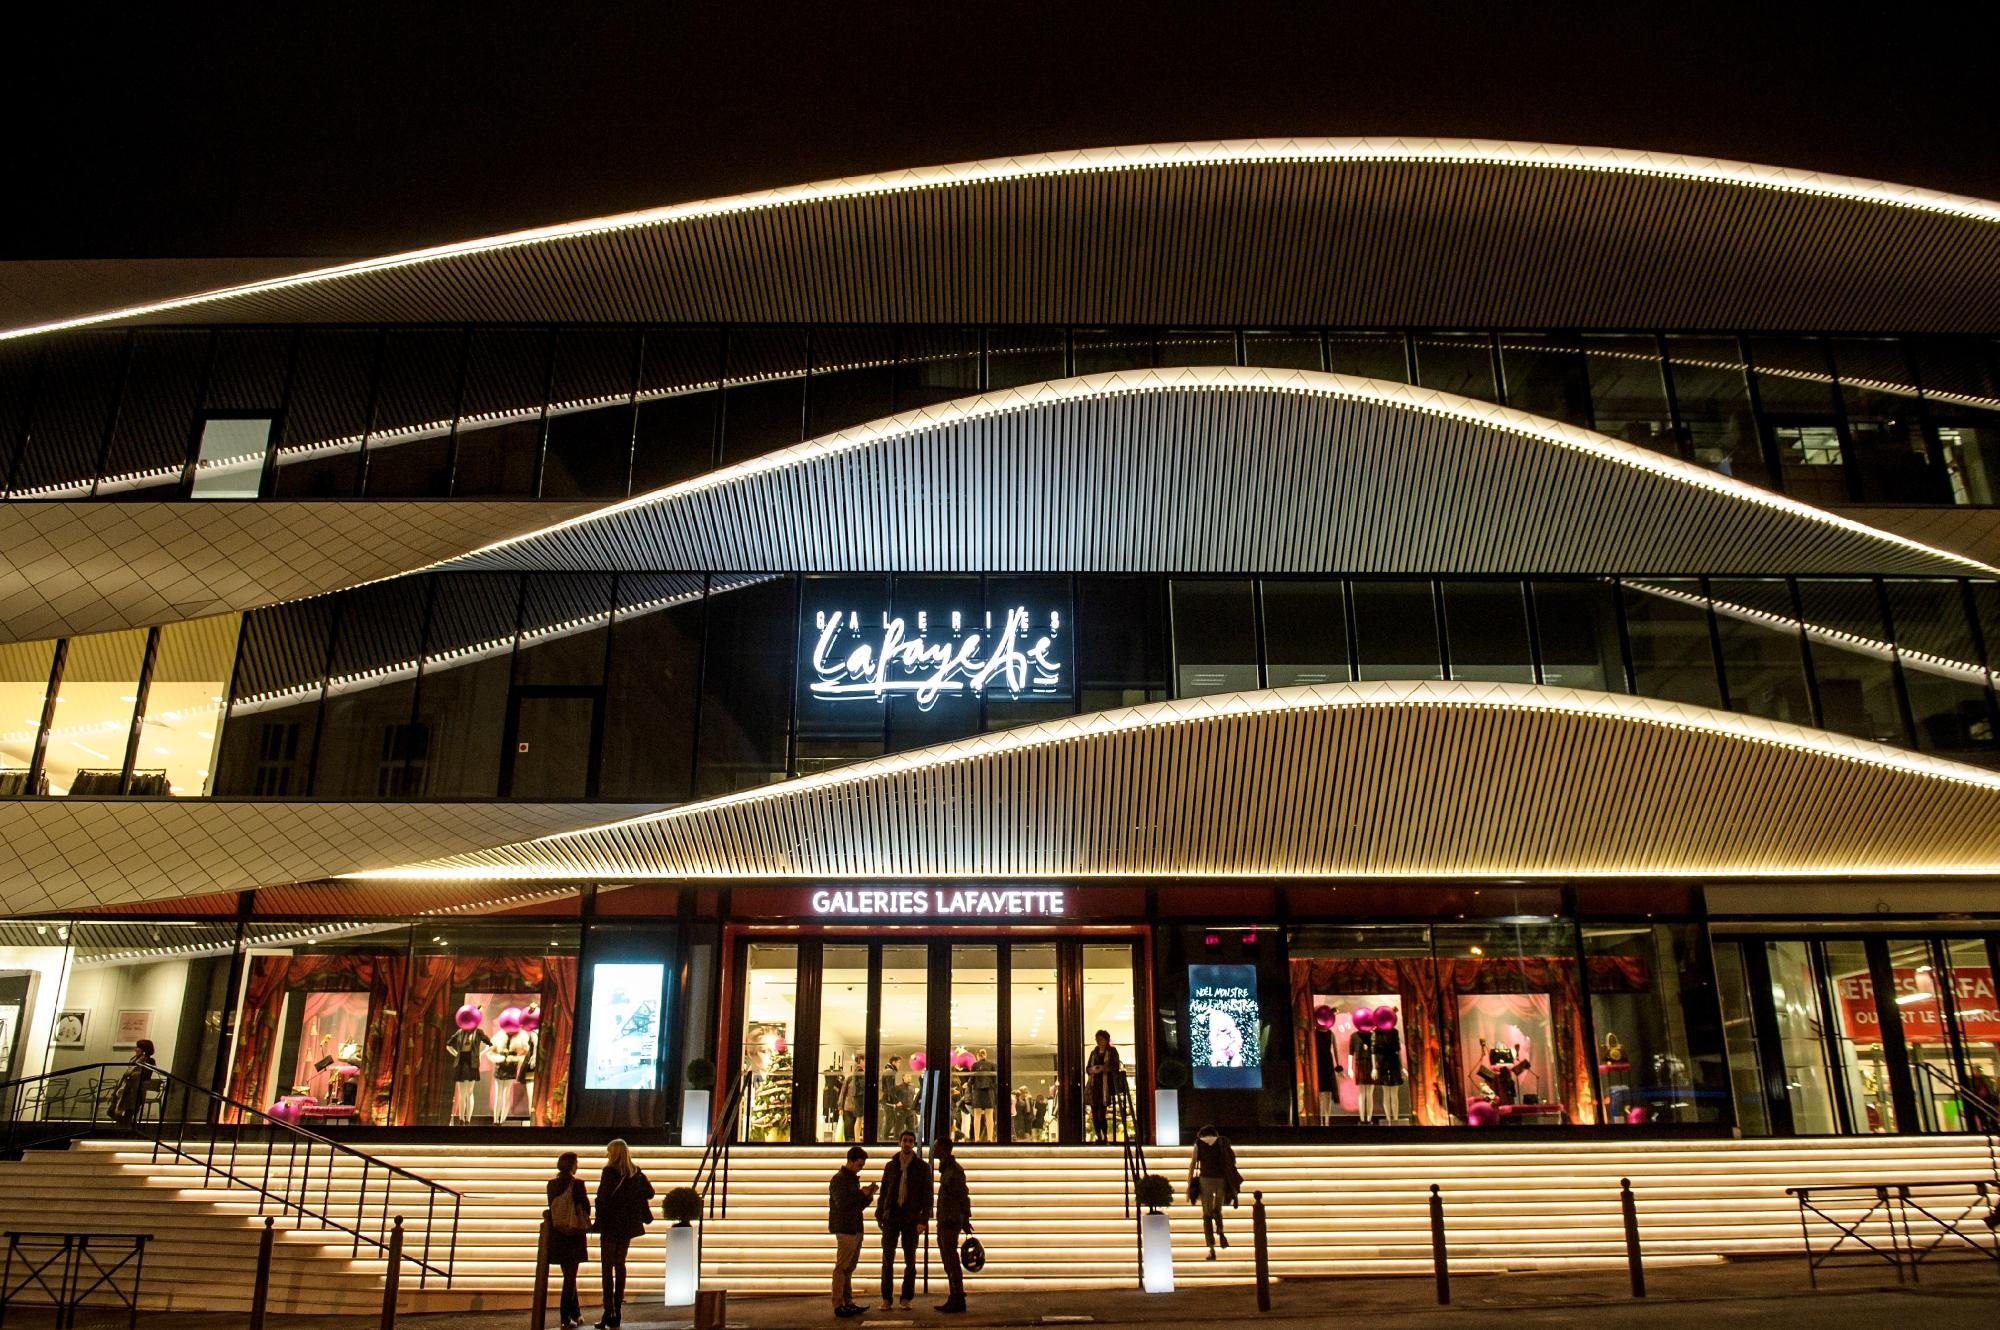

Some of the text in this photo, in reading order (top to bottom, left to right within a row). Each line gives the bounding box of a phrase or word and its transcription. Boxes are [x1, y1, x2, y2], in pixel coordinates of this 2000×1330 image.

[816, 611, 1059, 629] GALERIES
[812, 891, 1064, 913] GALERIES LAFAYETTE
[1855, 1011, 1916, 1024] OURT
[1918, 1010, 1937, 1023] LE
